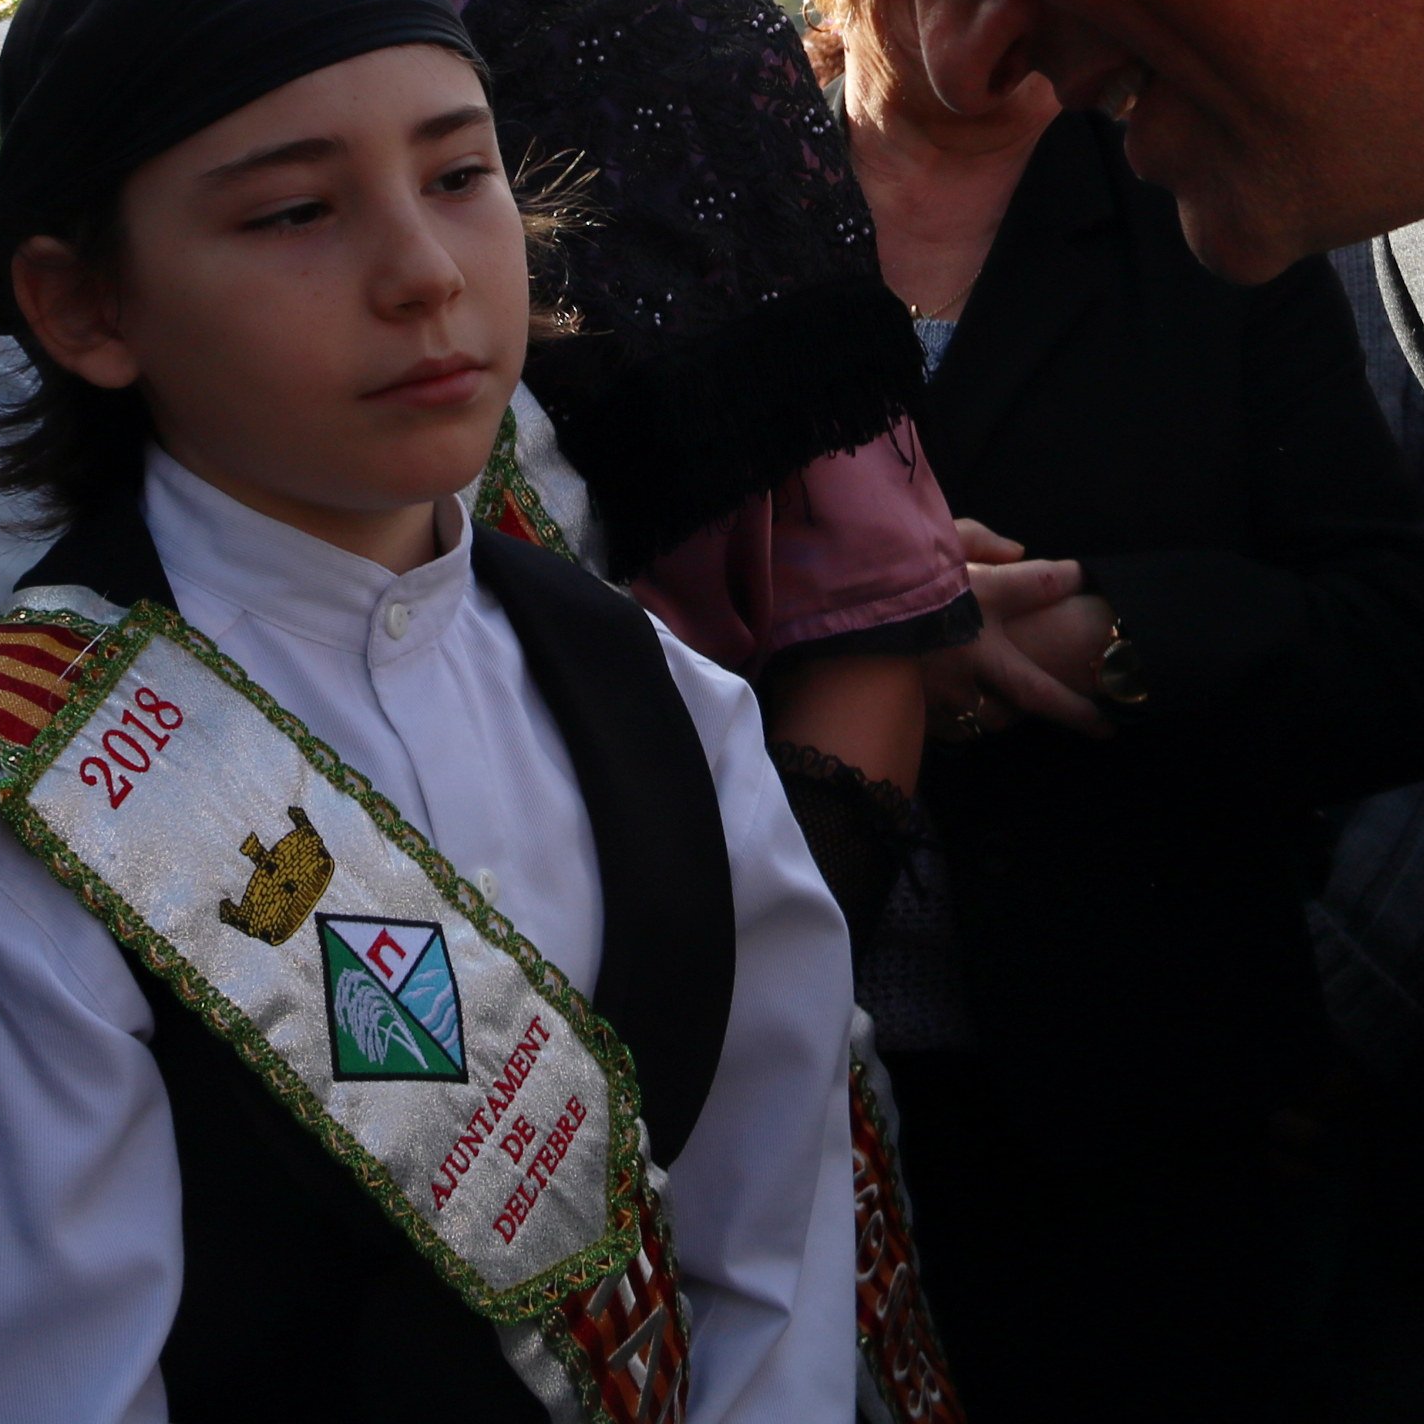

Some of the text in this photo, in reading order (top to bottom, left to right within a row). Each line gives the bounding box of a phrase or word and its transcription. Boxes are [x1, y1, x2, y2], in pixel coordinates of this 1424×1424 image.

[78, 686, 184, 810] 2018
[430, 1014, 551, 1211] AJUNTAMENT
[492, 1094, 588, 1246] DELTEBRE
[499, 1113, 537, 1166] DE
